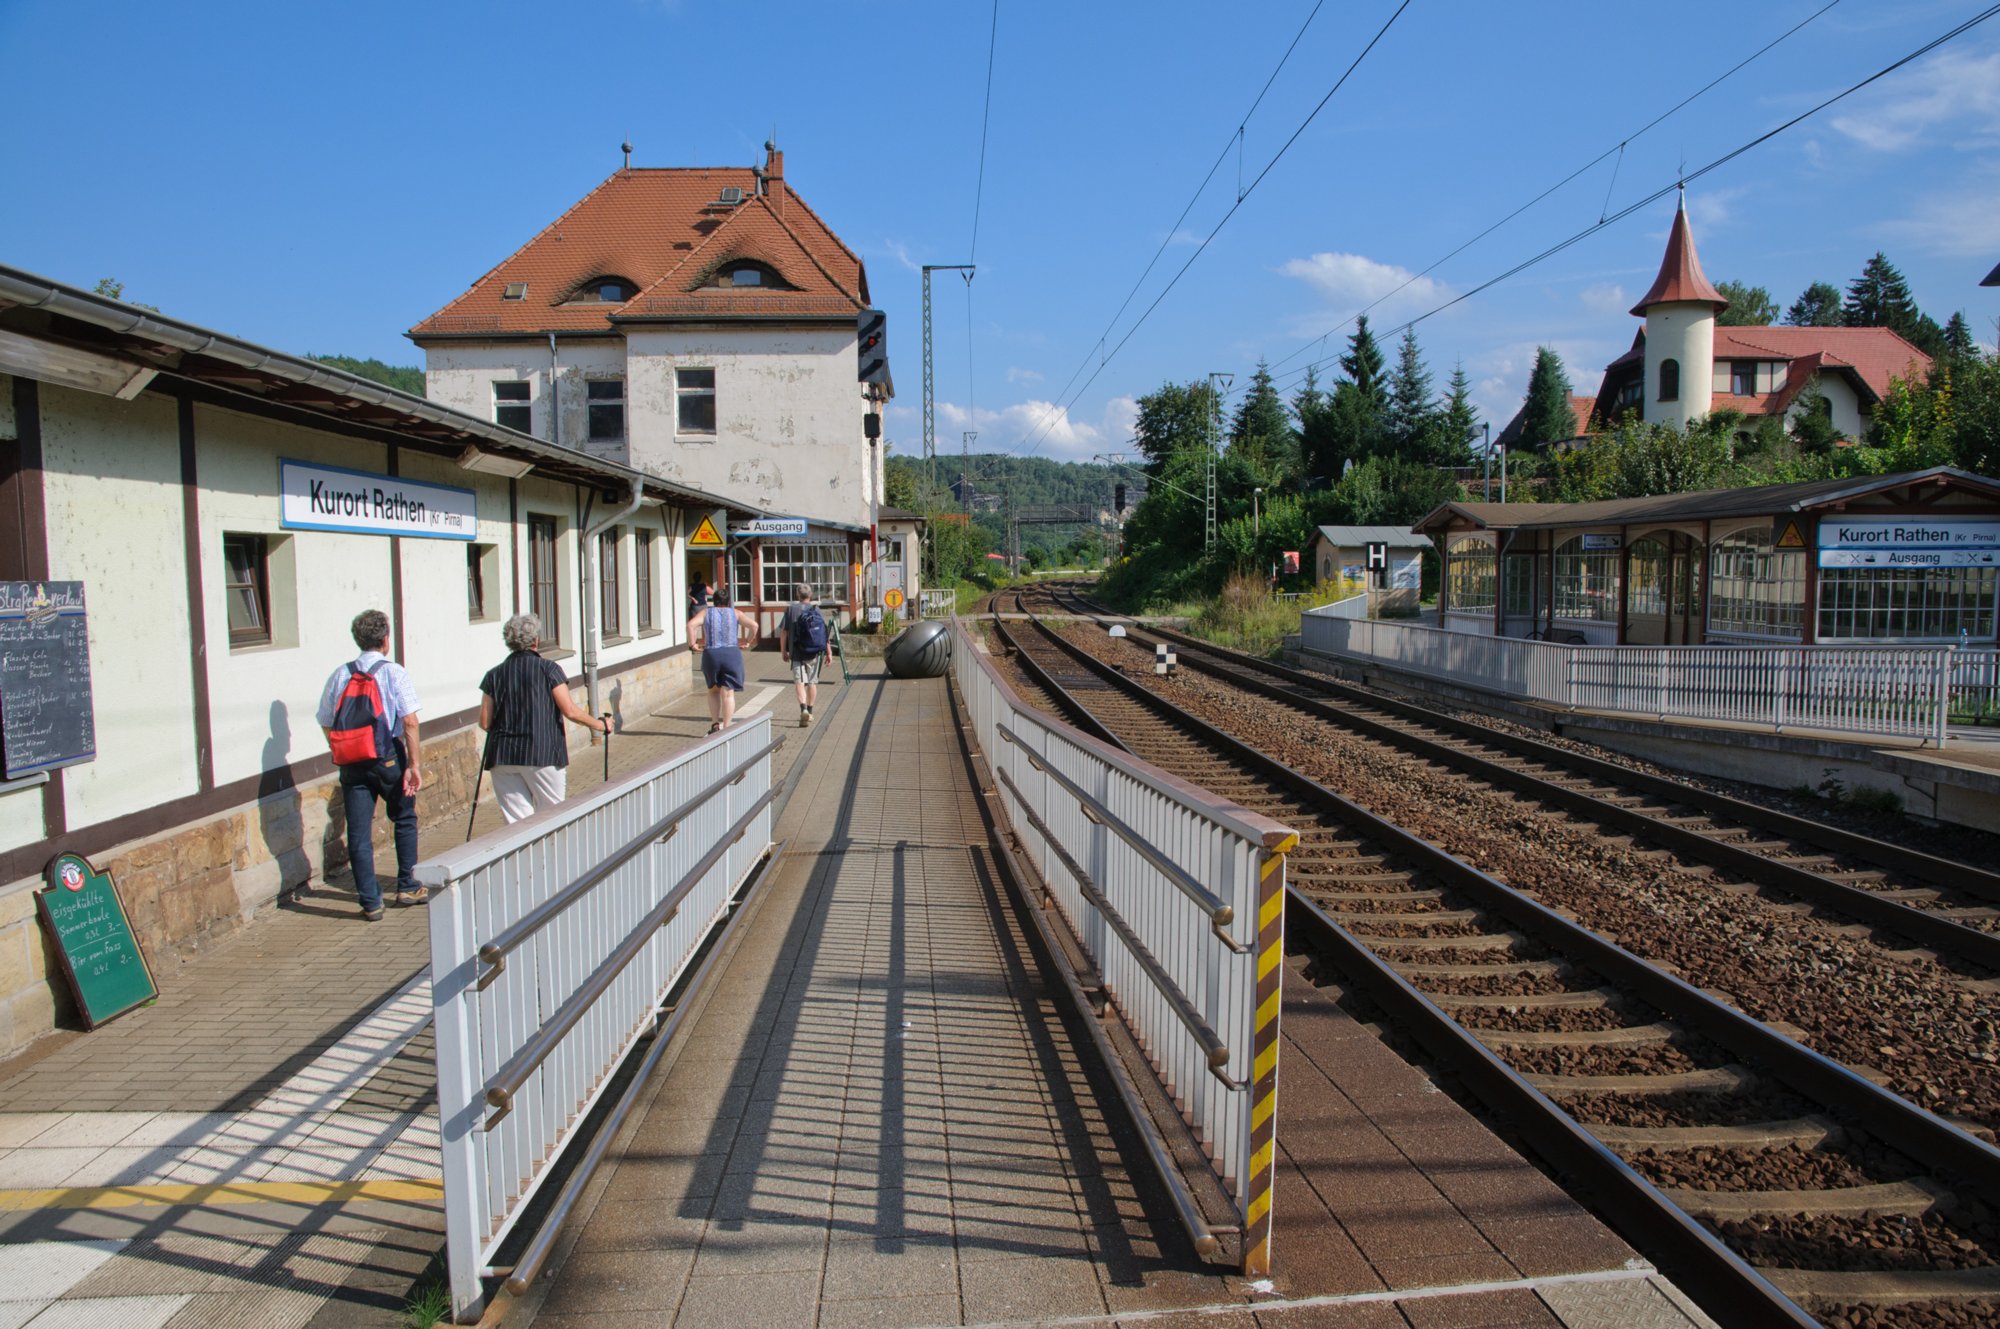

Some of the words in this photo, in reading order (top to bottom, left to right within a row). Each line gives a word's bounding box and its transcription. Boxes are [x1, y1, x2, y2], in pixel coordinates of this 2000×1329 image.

[310, 479, 369, 518] Kurort
[373, 488, 426, 523] Rathen
[444, 511, 463, 530] Pirna)
[753, 521, 803, 533] Ausgang
[1839, 527, 1889, 542] Kurort
[1894, 527, 1950, 542] Rathen
[1954, 533, 1967, 542] (Kr
[1972, 533, 1996, 542] Pirna)
[1369, 544, 1385, 568] H
[1888, 552, 1941, 565] Ausgang
[0, 620, 27, 632] Flasche
[53, 890, 104, 920] eisgekühlte
[70, 956, 86, 969] Bier
